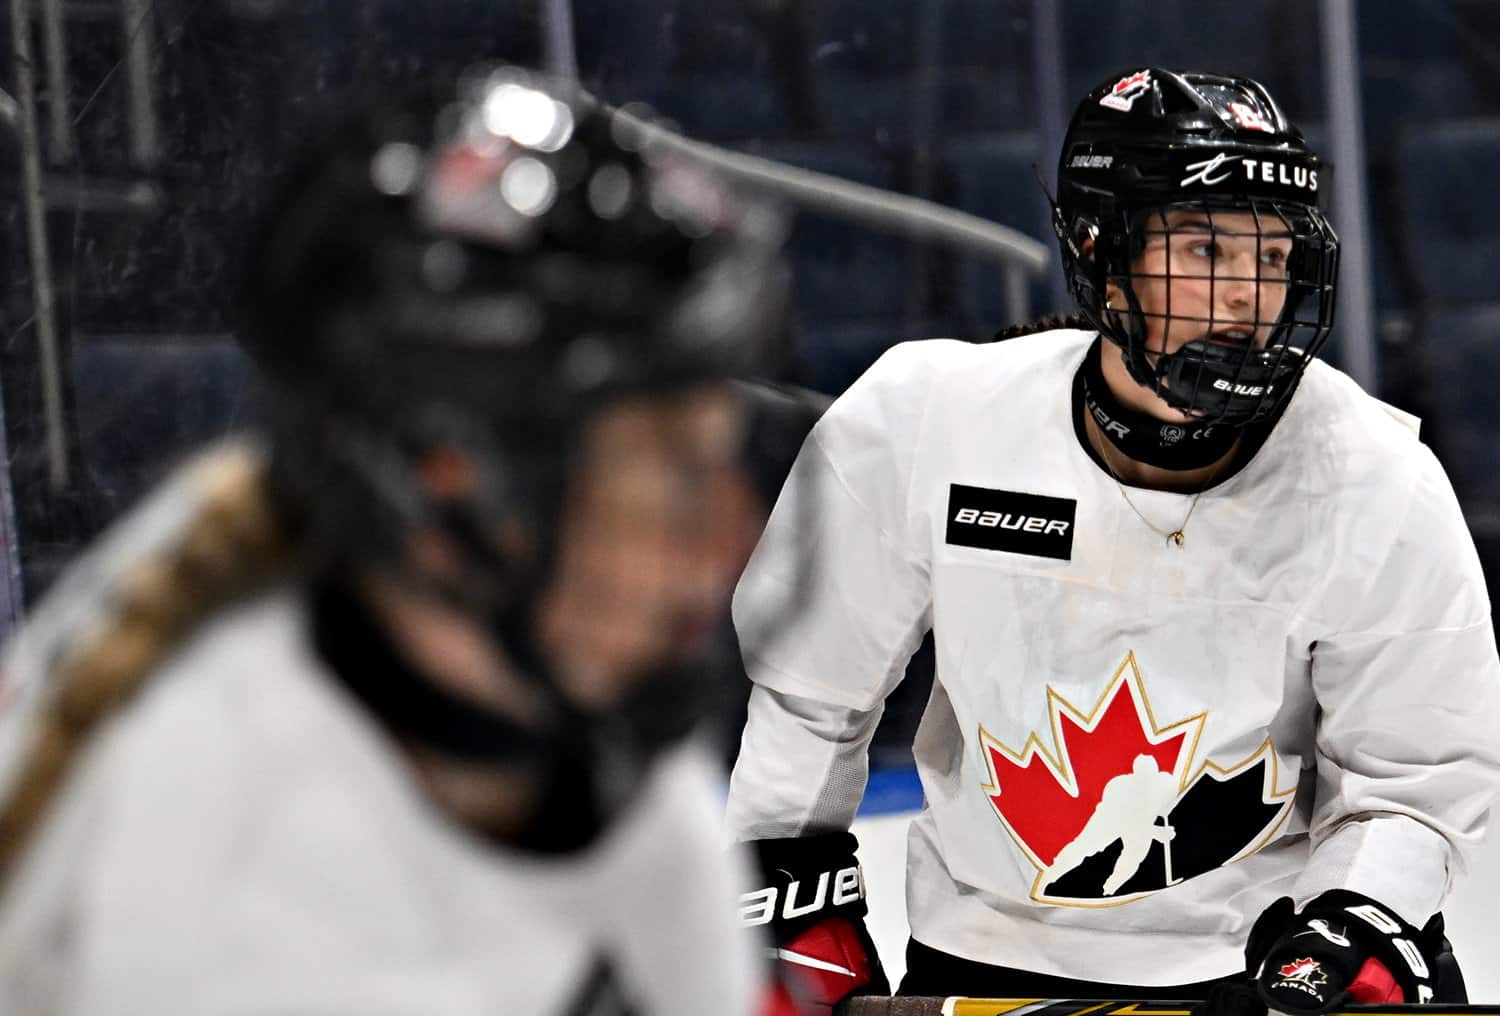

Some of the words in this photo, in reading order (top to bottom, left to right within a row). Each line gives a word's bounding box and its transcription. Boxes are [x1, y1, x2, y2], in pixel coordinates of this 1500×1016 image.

[1242, 158, 1318, 191] TELUS
[954, 507, 1070, 537] BAUER
[737, 864, 866, 929] AUE
